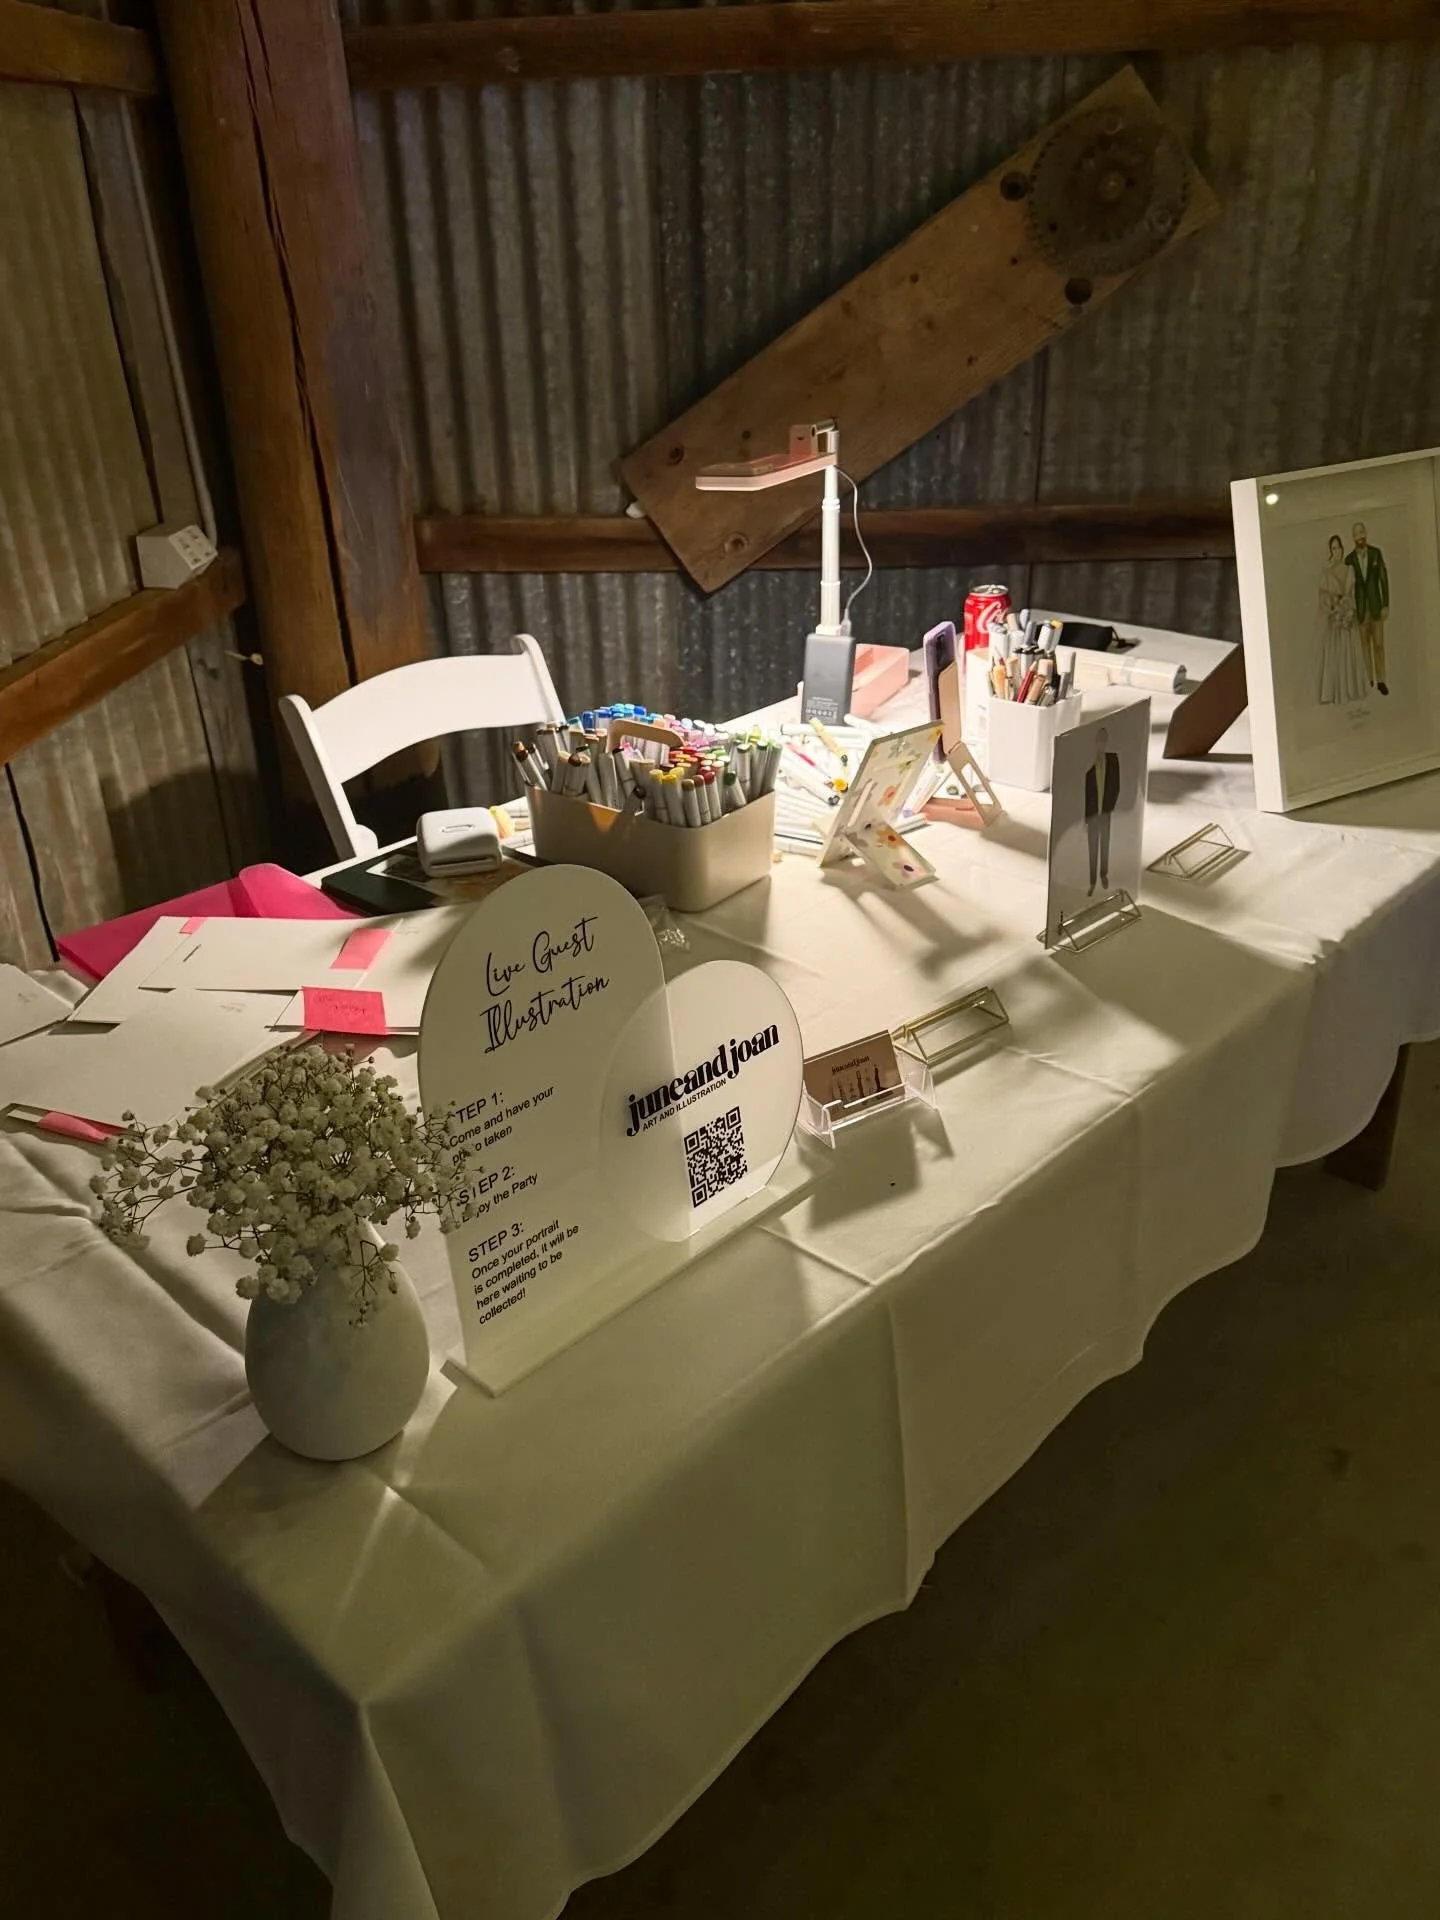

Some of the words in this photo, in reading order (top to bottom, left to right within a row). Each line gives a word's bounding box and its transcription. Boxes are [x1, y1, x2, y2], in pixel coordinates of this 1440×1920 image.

[486, 952, 526, 997] Live
[532, 916, 599, 974] Guest
[479, 975, 610, 1054] Illustration
[449, 1098, 487, 1124] TEP
[492, 1092, 504, 1106] 1:
[450, 1126, 481, 1148] Come
[484, 1112, 504, 1131] and
[505, 1100, 530, 1119] have
[532, 1086, 554, 1107] your
[642, 1118, 658, 1131] ART
[658, 1107, 675, 1122] AND
[676, 1078, 727, 1112] ILLUSTRATION
[452, 1142, 482, 1166] pho
[485, 1126, 513, 1147] taken
[493, 1189, 510, 1207] the
[511, 1173, 538, 1195] Party
[502, 1166, 516, 1182] 2:
[468, 1230, 508, 1263] STEP
[511, 1222, 524, 1237] 3:
[472, 1257, 499, 1279] Once
[501, 1242, 524, 1264] your
[526, 1220, 560, 1249] portrait
[474, 1284, 483, 1295] is
[485, 1250, 540, 1288] completed,
[541, 1244, 548, 1254] it
[549, 1232, 565, 1249] will
[566, 1225, 579, 1238] be
[477, 1290, 500, 1310] here
[502, 1267, 537, 1293] waiting
[538, 1260, 548, 1271] to
[550, 1251, 563, 1264] be
[479, 1287, 526, 1324] collected!
